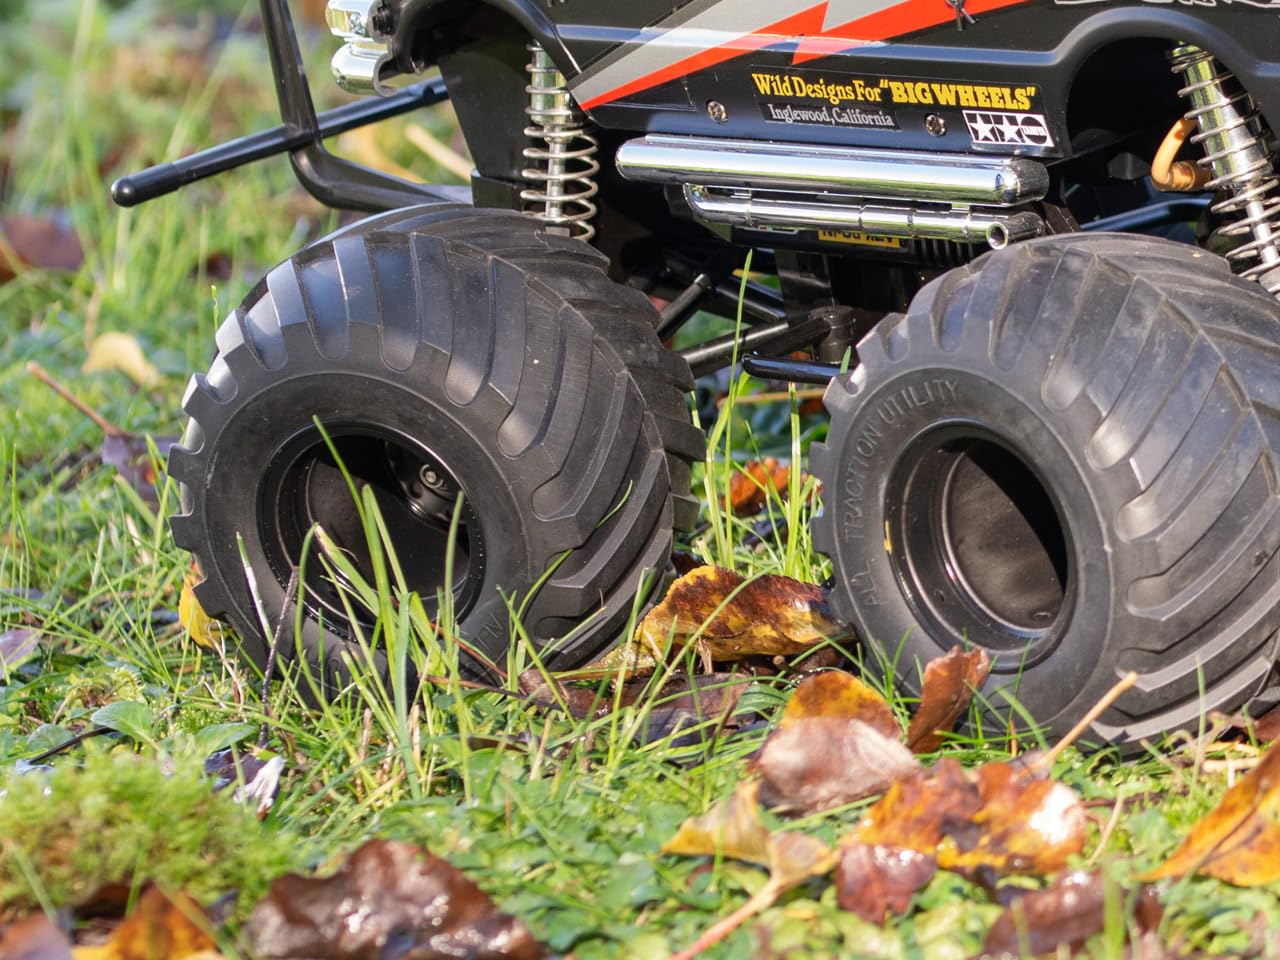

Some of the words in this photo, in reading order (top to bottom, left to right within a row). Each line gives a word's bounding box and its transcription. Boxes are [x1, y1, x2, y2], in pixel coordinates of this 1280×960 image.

[752, 73, 792, 96] Wild
[791, 76, 854, 105] Designs
[852, 79, 882, 102] For
[844, 427, 883, 545] TRACTION
[876, 378, 959, 425] UTILITY
